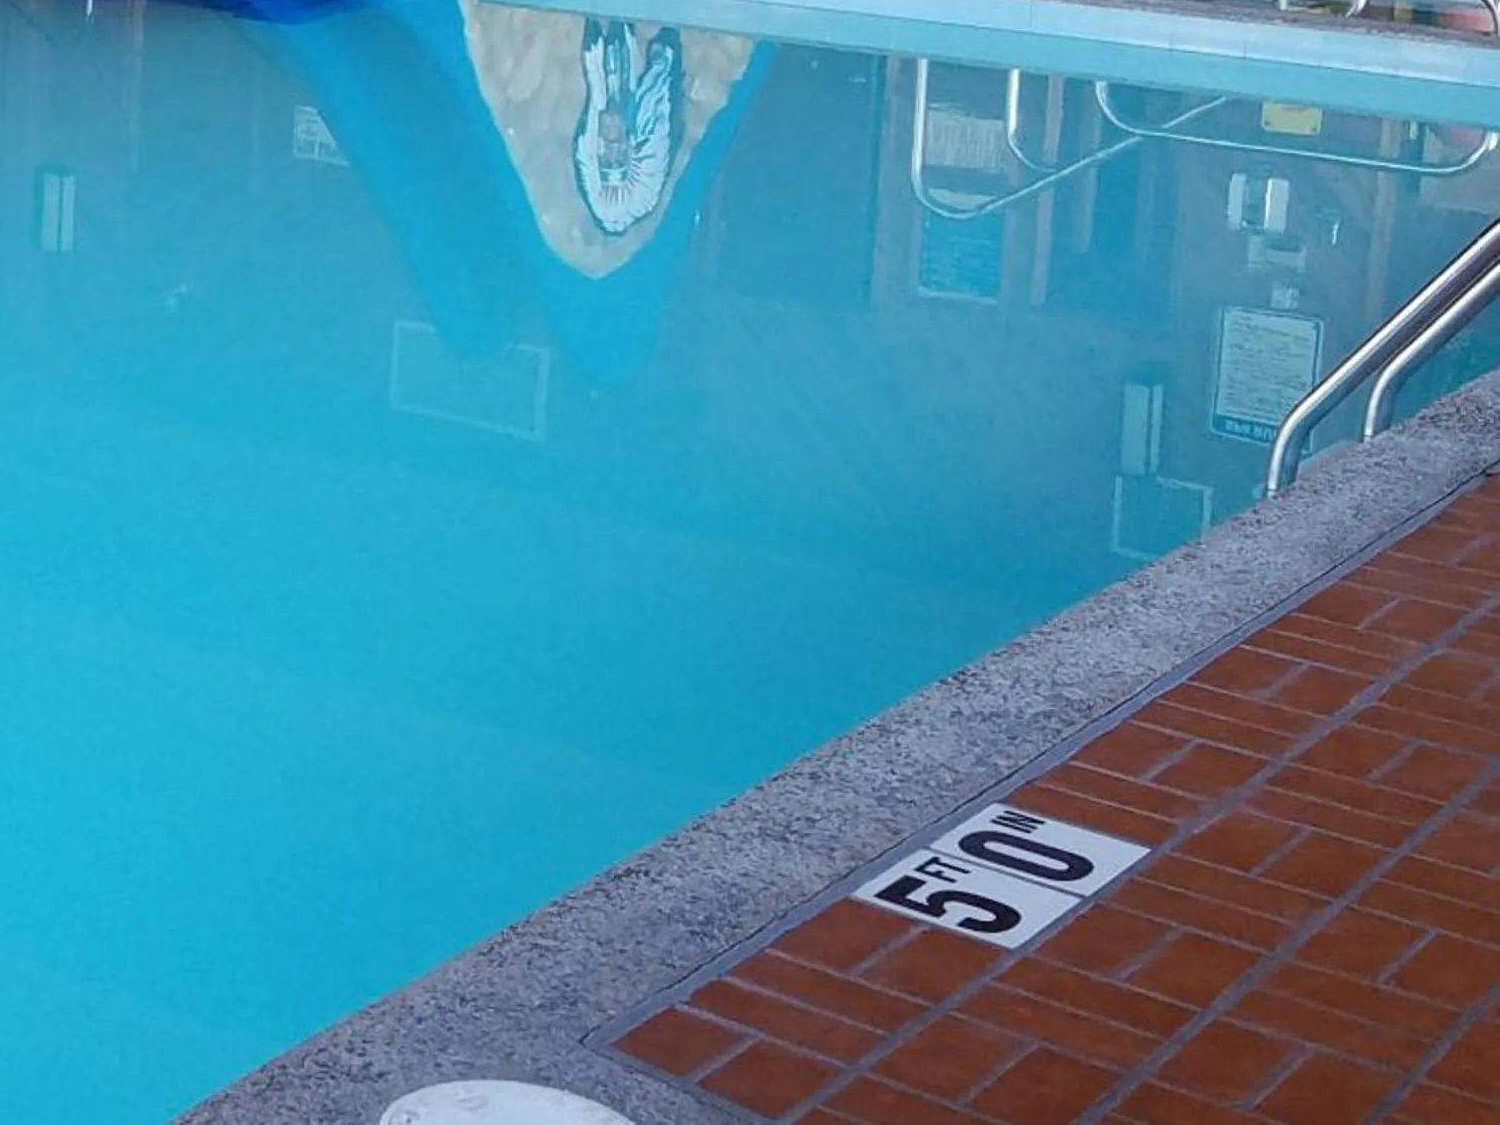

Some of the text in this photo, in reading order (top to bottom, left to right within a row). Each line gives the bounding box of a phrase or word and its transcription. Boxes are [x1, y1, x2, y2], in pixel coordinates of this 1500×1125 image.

[873, 810, 1094, 934] 5 FT 0 IN
